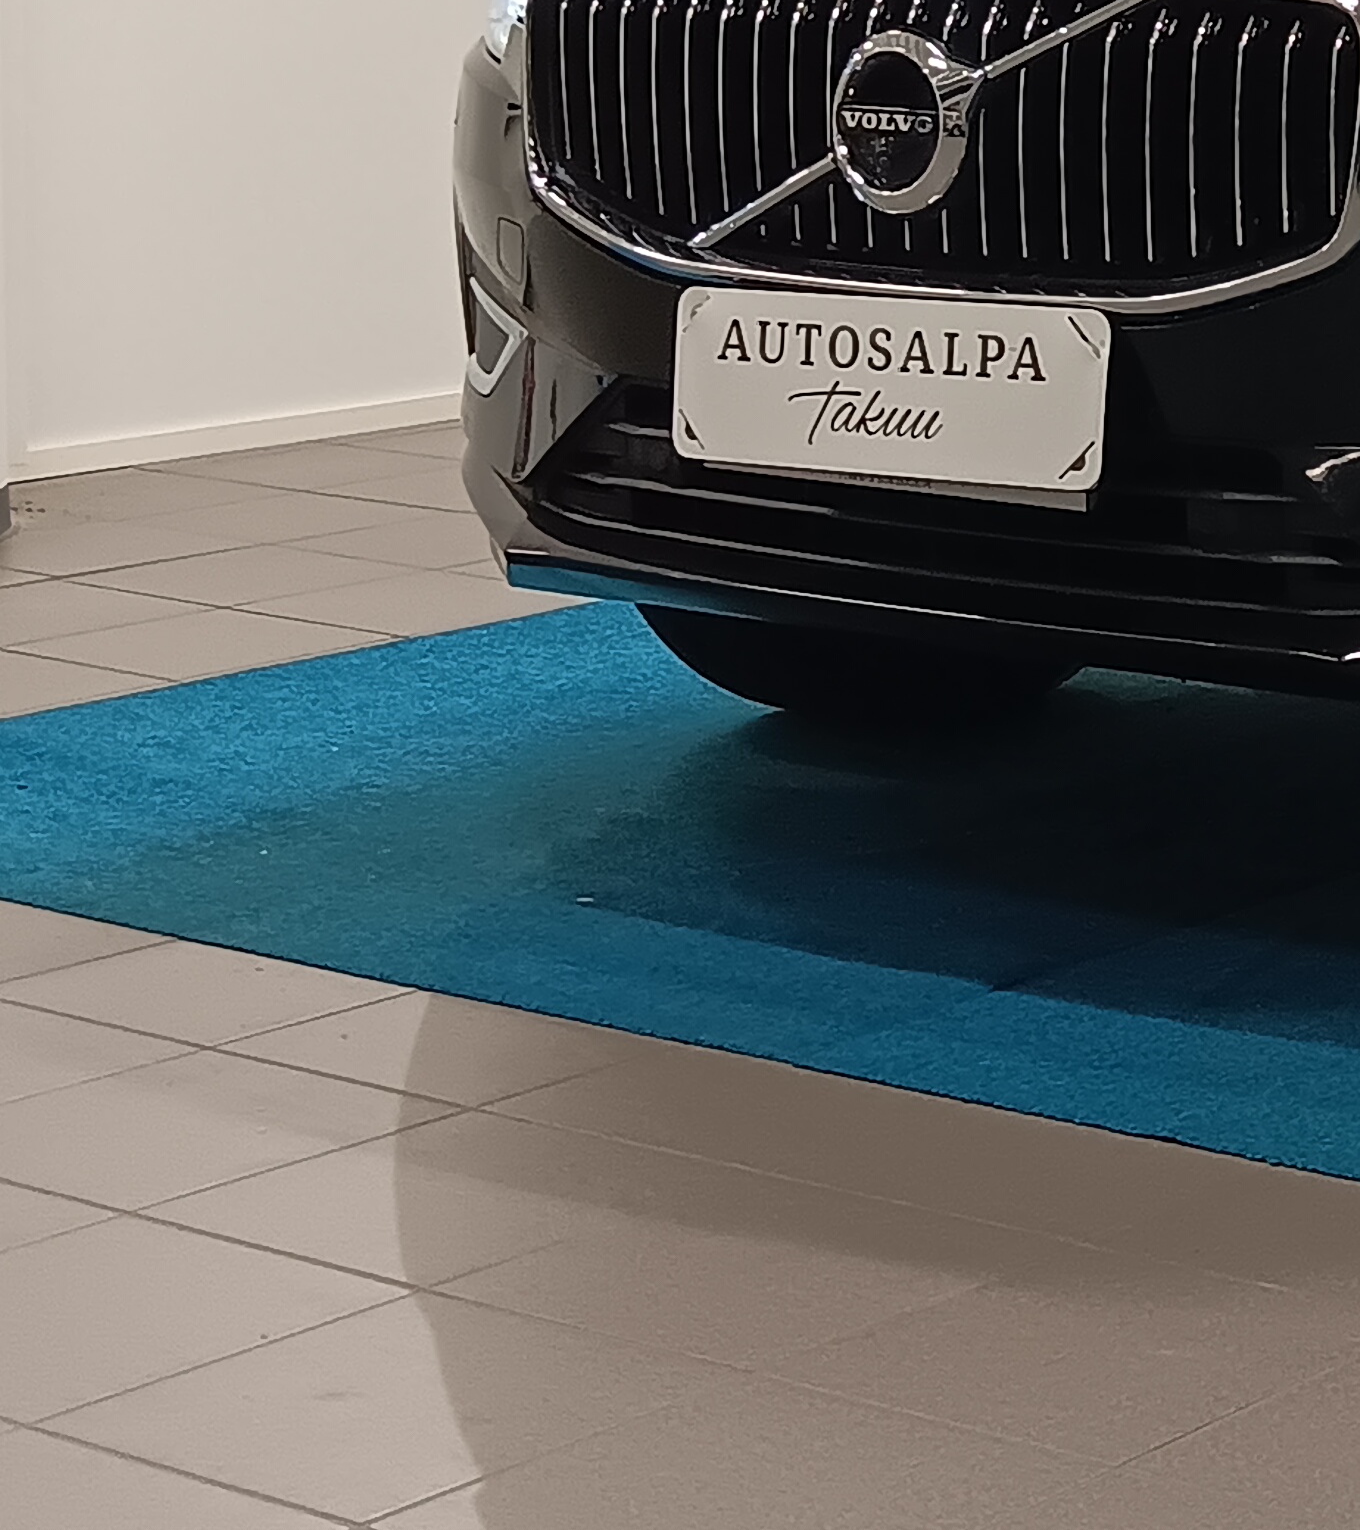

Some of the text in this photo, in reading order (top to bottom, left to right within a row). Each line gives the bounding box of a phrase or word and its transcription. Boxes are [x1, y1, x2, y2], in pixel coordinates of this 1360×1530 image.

[841, 110, 934, 133] VOLVO
[717, 319, 1046, 382] AUTOSALPA
[787, 381, 944, 445] Takuu
